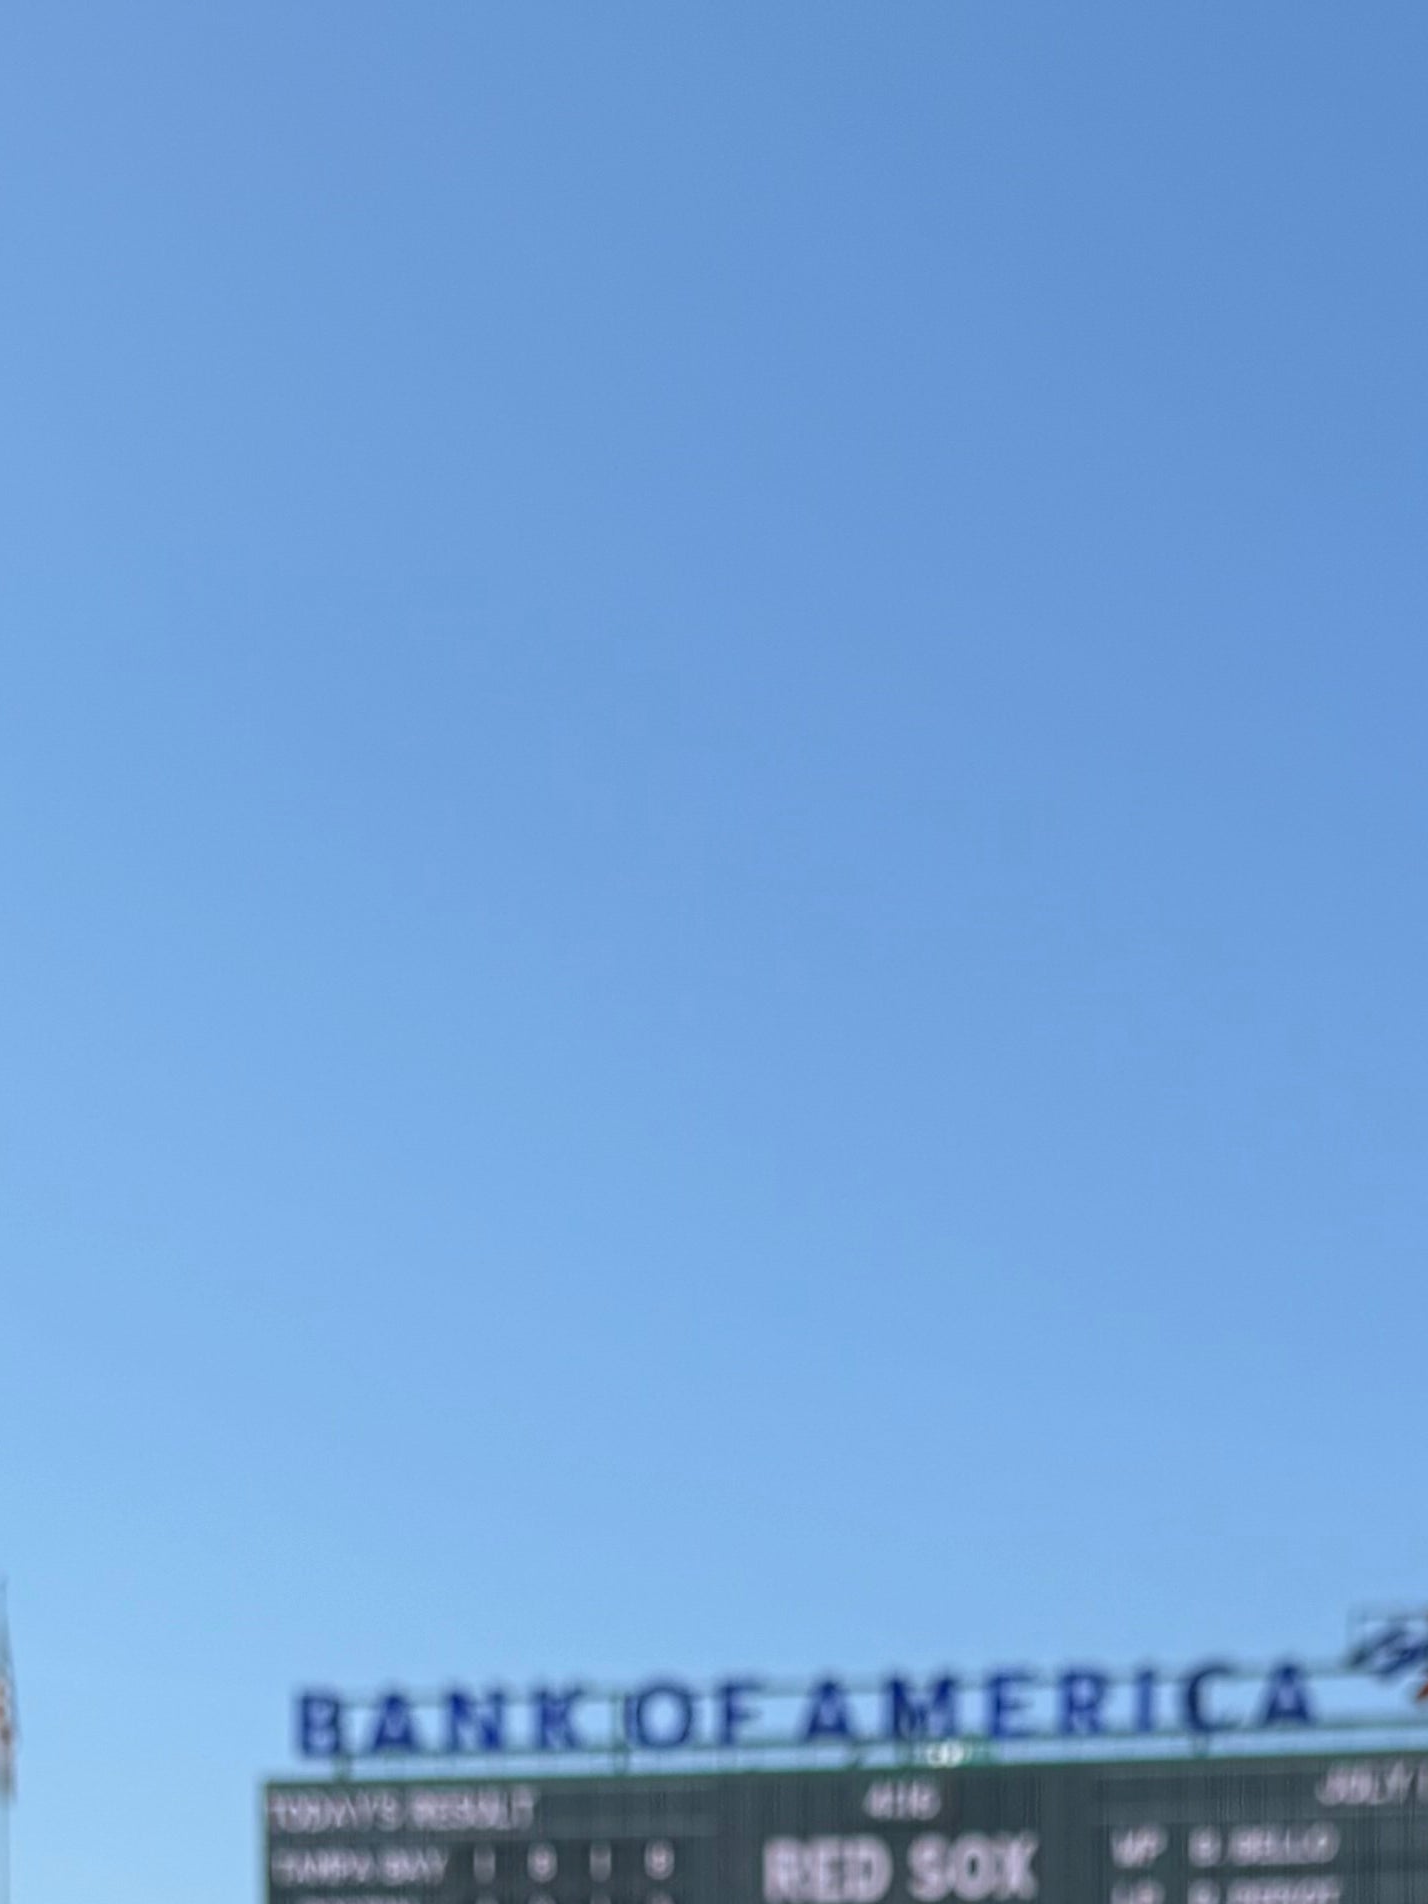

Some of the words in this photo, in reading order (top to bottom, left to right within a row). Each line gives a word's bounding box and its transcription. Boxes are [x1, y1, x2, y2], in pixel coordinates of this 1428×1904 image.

[290, 1688, 586, 1760] BANK
[626, 1676, 766, 1752] OF
[800, 1660, 1319, 1750] AMERICA
[764, 1834, 893, 1904] RED
[908, 1830, 1038, 1902] SOX
